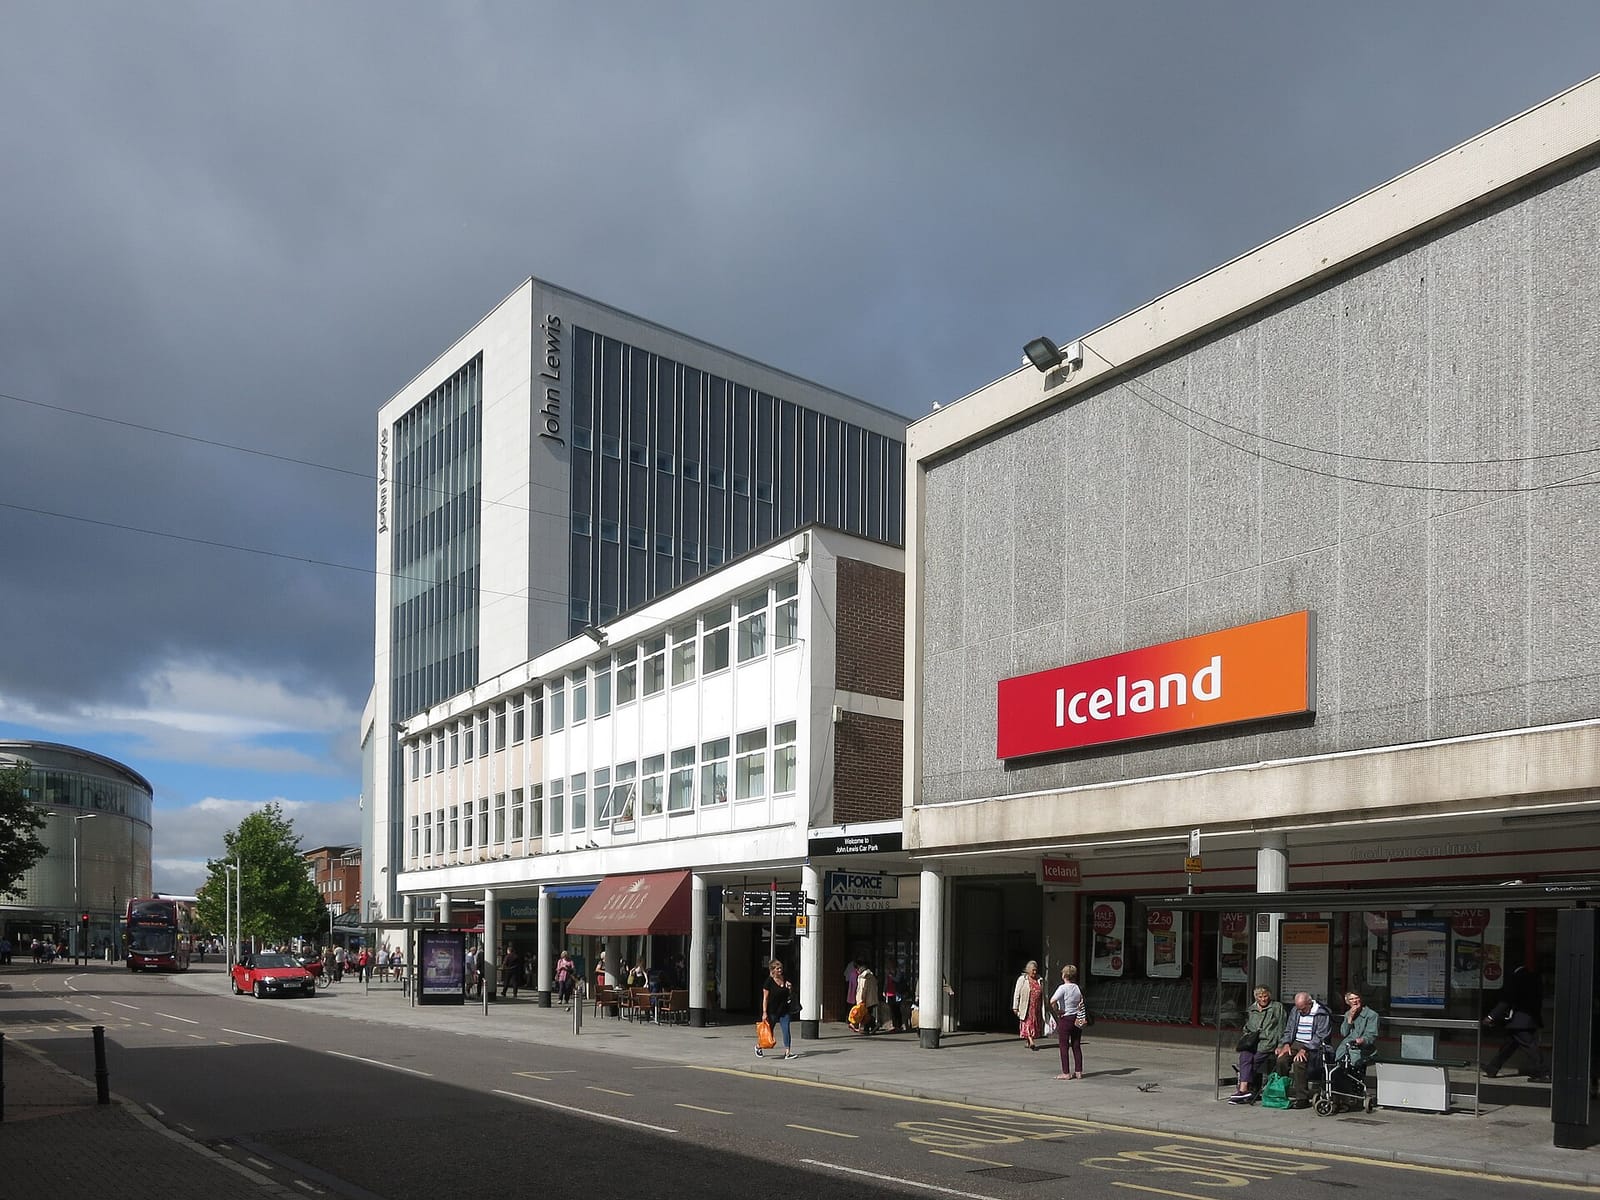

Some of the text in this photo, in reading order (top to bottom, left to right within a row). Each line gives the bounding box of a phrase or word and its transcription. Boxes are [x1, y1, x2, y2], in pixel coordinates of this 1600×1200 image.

[538, 313, 565, 448] John Lewis
[1055, 655, 1222, 728] Iceland
[835, 846, 847, 854] John
[846, 845, 859, 853] Lewis
[1385, 847, 1412, 863] you
[1415, 847, 1440, 857] can
[1446, 840, 1481, 854] trust
[1044, 864, 1078, 878] Iceland
[848, 875, 882, 889] FORCE
[866, 900, 890, 910] SONS
[1094, 911, 1114, 920] HALF
[1093, 920, 1113, 929] PRICE
[894, 1114, 1101, 1150] STOP
[1079, 1143, 1332, 1188] BUS
